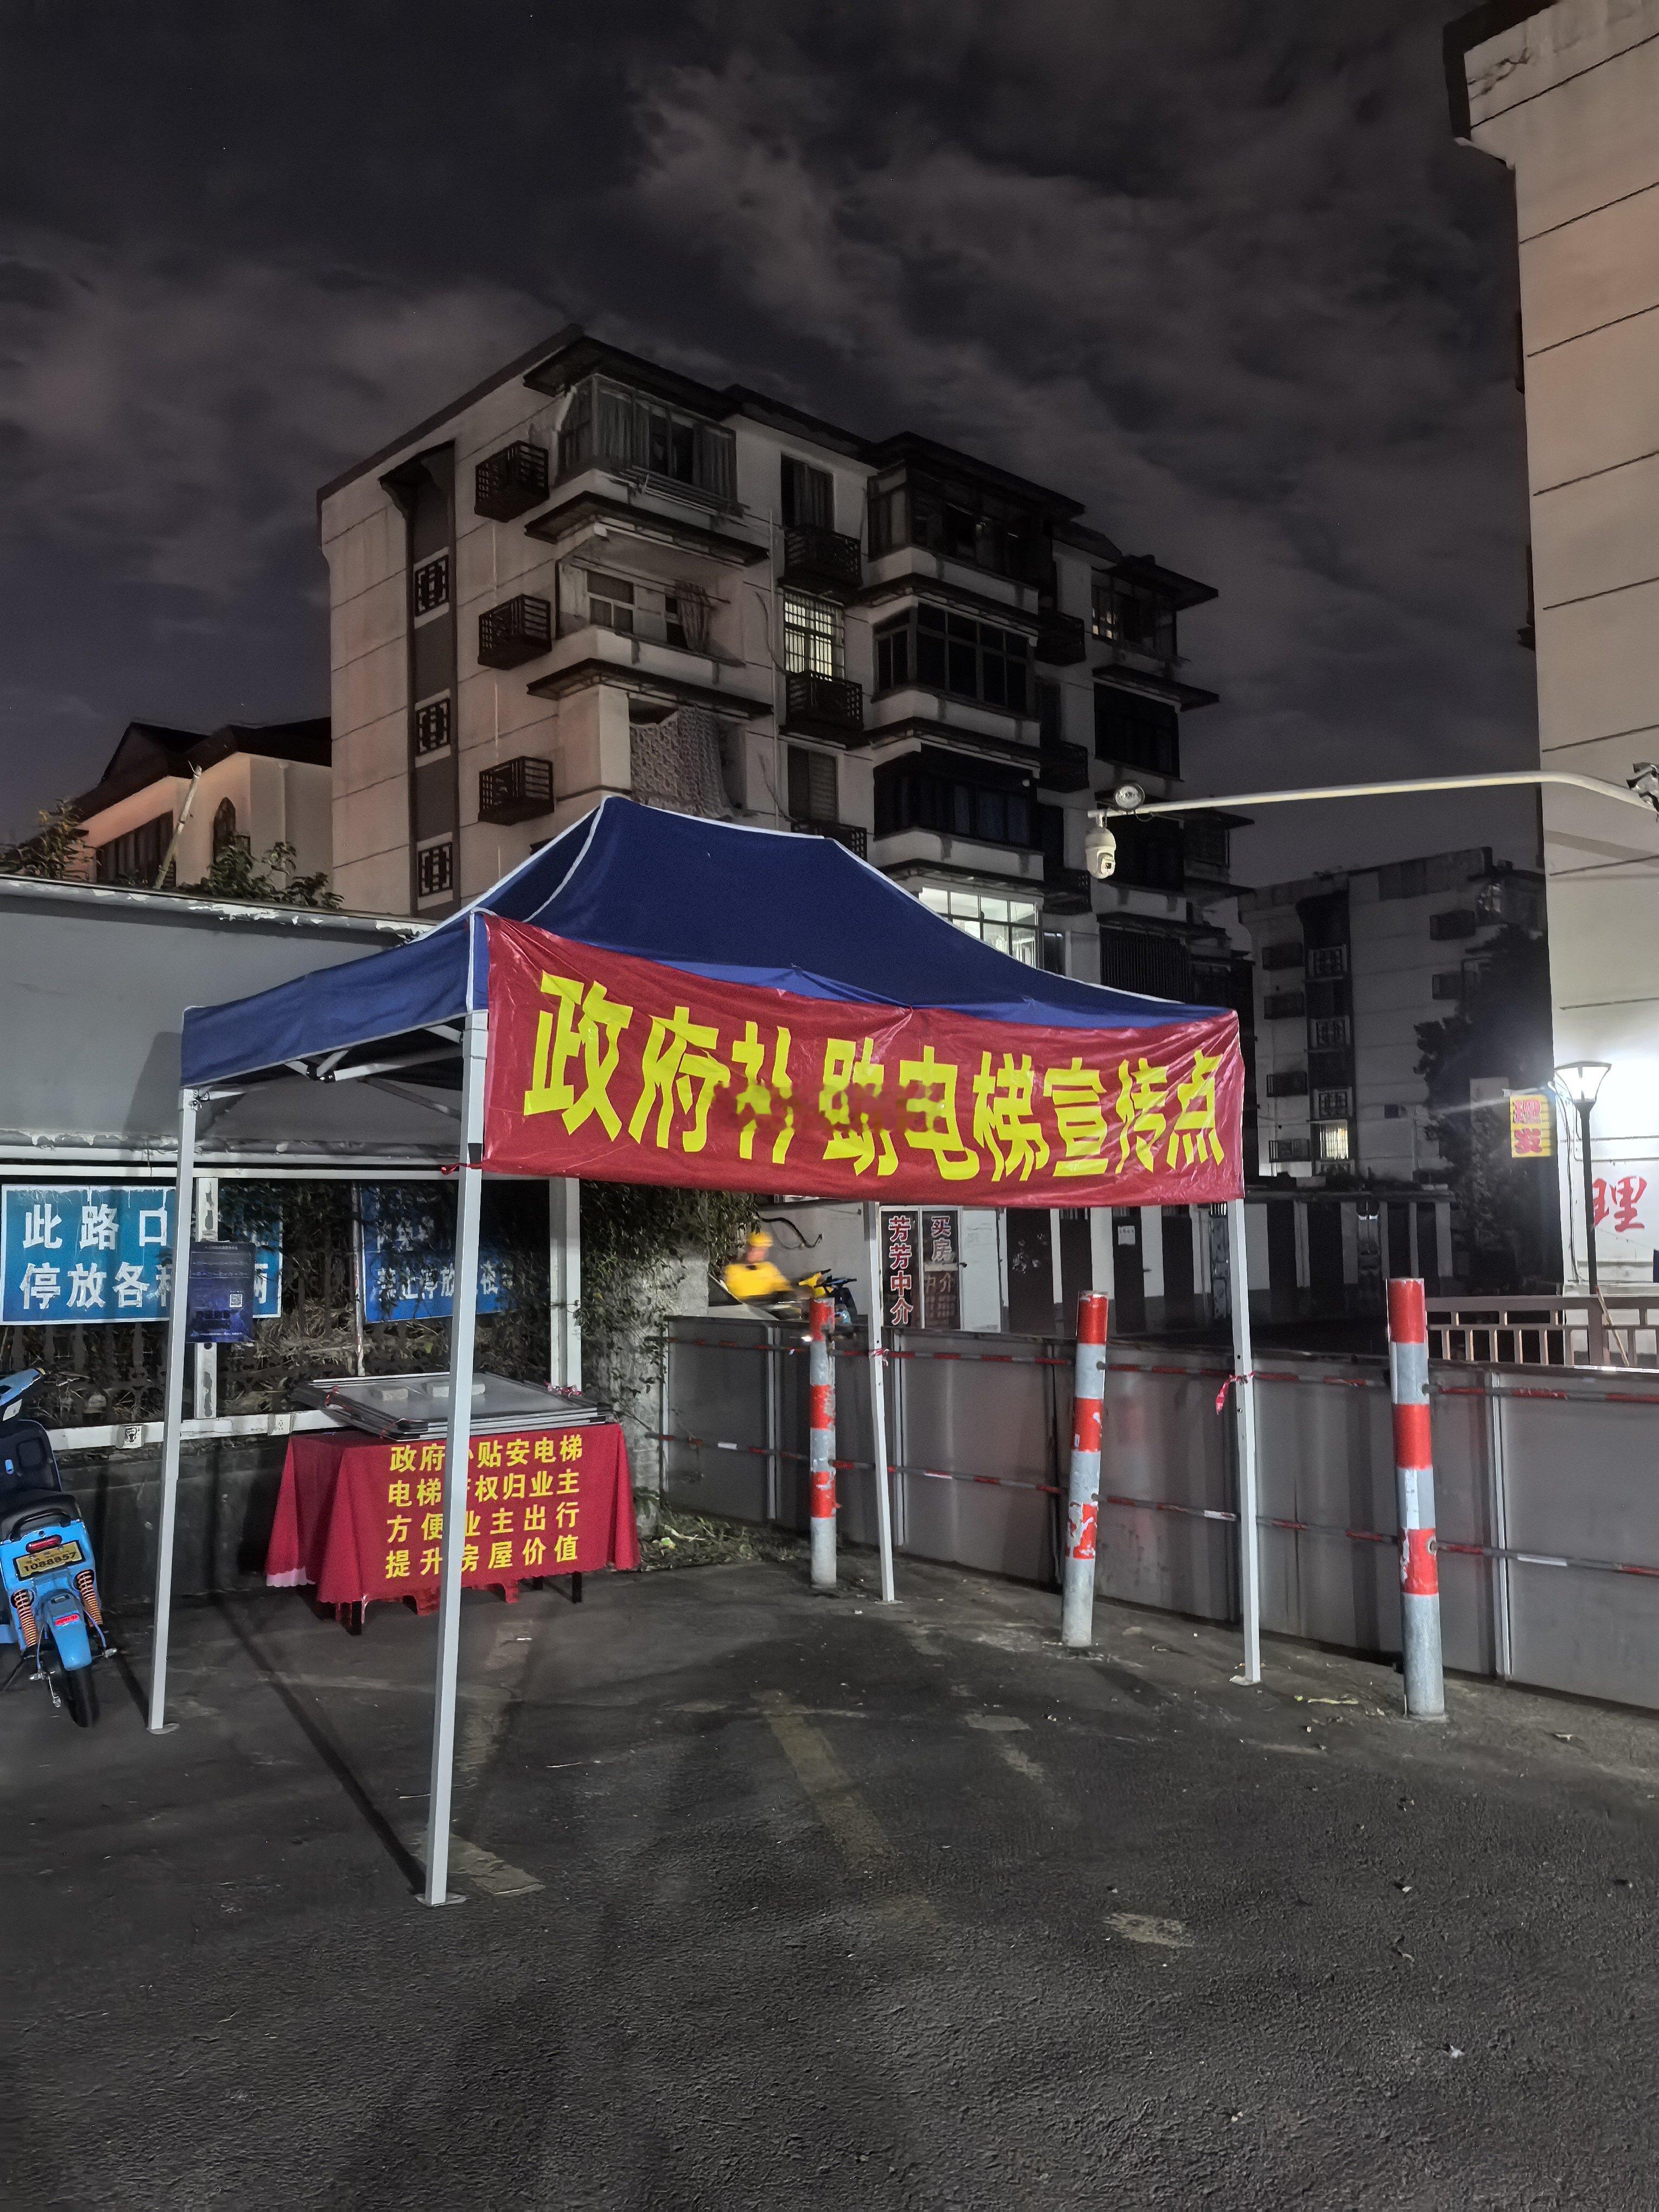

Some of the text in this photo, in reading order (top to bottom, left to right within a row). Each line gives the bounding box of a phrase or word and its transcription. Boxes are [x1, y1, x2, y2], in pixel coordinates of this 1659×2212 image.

[524, 969, 1225, 1182] 政府补助电梯宣传点
[888, 1215, 914, 1325] 芳芳中介
[390, 1434, 583, 1473] 政府贴安电梯
[388, 1468, 579, 1508] 电梯权归业主
[385, 1535, 578, 1579] 提升房屋价值
